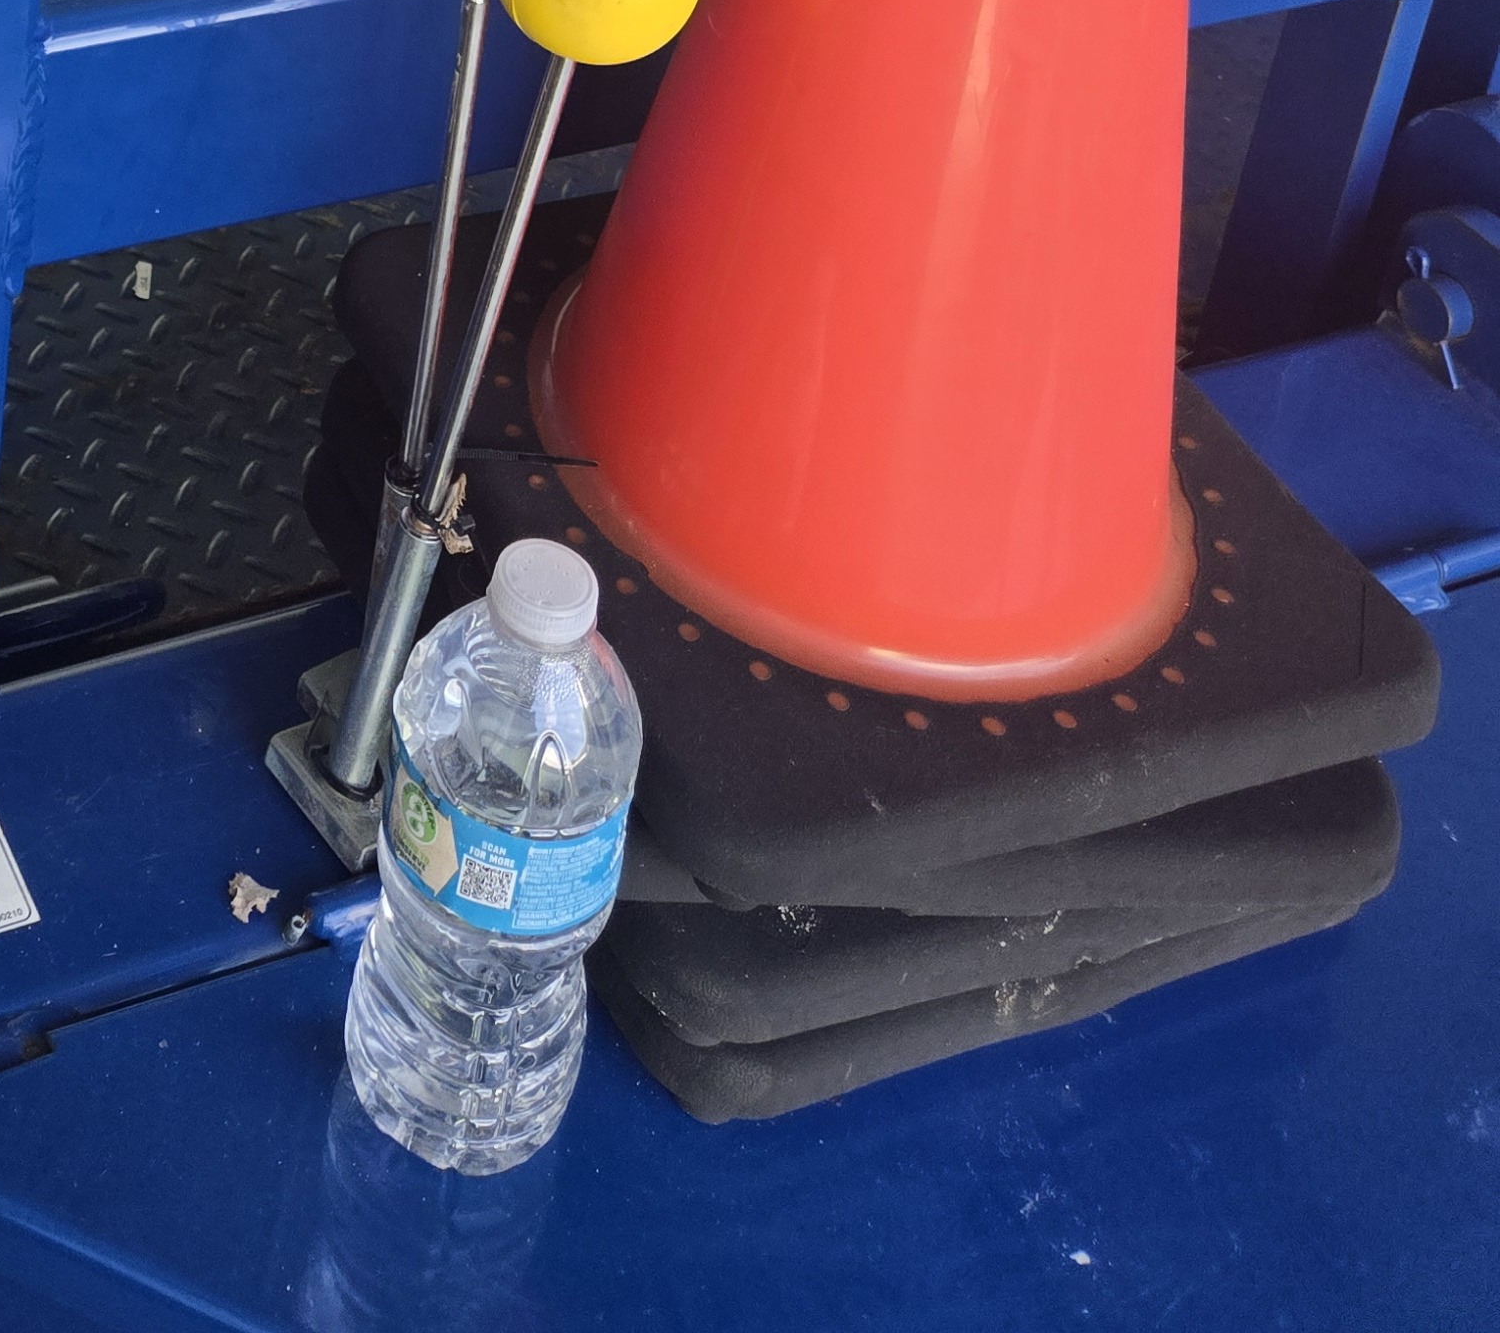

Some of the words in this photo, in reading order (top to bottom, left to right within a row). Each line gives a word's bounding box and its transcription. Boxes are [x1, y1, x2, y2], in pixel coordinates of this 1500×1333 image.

[469, 845, 487, 861] FOR
[488, 853, 516, 869] MORE
[481, 840, 507, 856] SCAN
